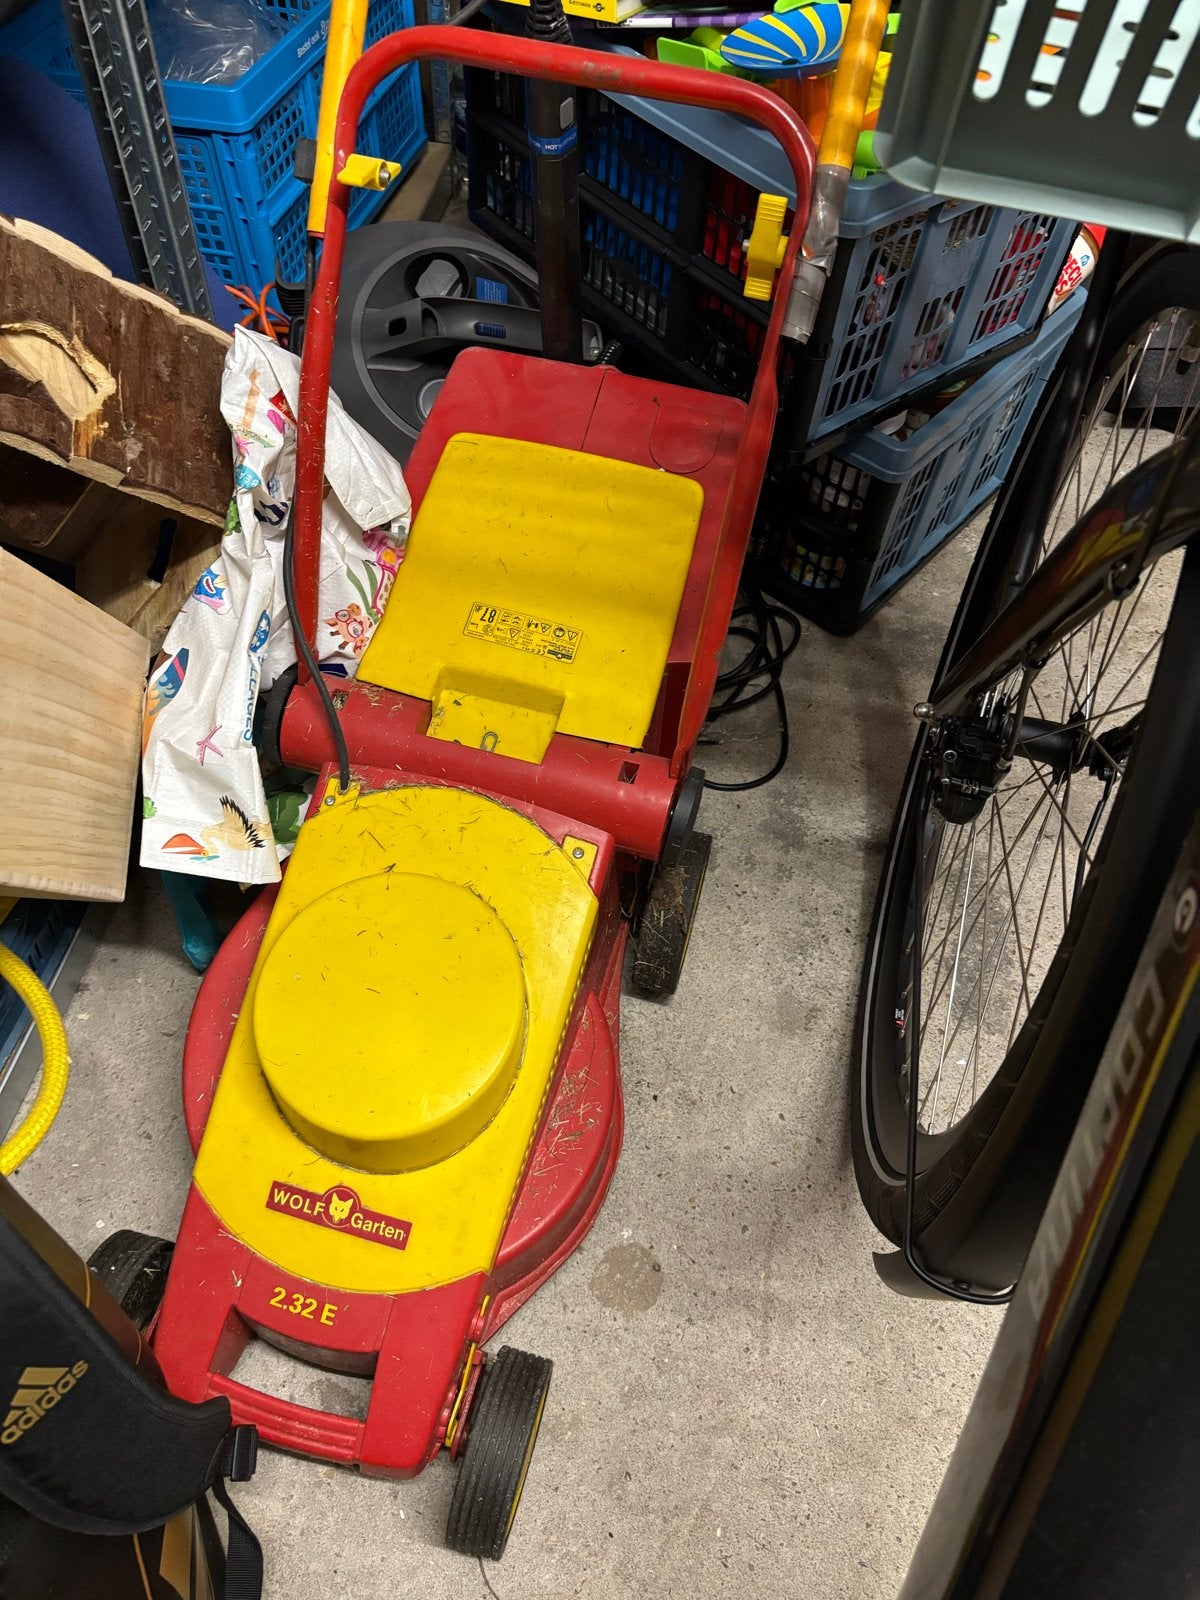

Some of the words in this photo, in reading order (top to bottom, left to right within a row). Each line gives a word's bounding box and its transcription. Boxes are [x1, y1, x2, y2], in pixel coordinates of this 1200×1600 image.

[480, 607, 497, 623] 87
[273, 1188, 326, 1216] WOLF
[351, 1212, 405, 1241] Garten
[269, 1286, 318, 1319] 2.32
[319, 1303, 338, 1326] E
[0, 1360, 89, 1445] adidas
